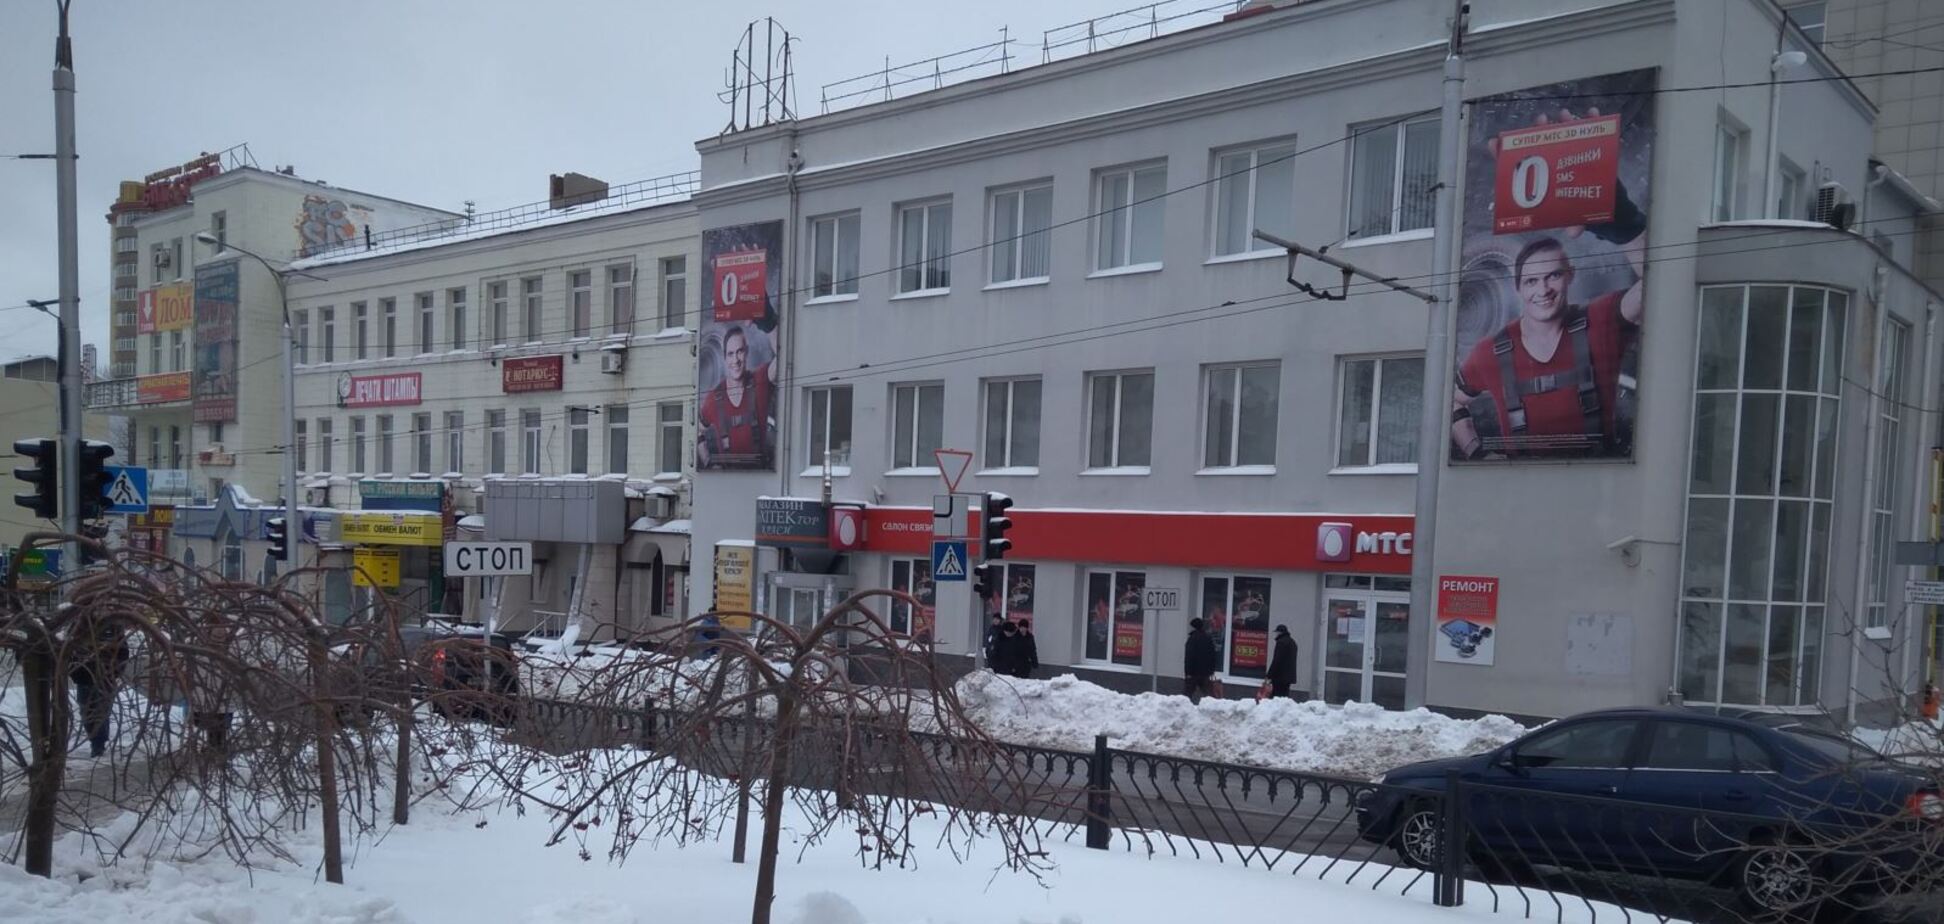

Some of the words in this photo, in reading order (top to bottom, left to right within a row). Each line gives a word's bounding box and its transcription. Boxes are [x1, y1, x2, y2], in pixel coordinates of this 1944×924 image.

[1512, 134, 1541, 147] СУПЕР
[1544, 131, 1562, 142] МТС
[1579, 125, 1607, 136] НУЛЬ
[1556, 147, 1602, 170] ДЗВІНКИ
[1511, 155, 1549, 210] 0
[1556, 170, 1575, 184] SMS
[1554, 185, 1602, 199] ІНТЕРНЕТ
[721, 272, 738, 306] 0
[374, 525, 398, 533] ОБМЕН
[399, 526, 422, 535] ВАЛЮТ
[882, 522, 909, 531] САЛОН
[1356, 531, 1412, 554] МТС
[456, 547, 523, 571] СТОП
[1443, 580, 1495, 592] РЕМОНТ
[1147, 591, 1177, 607] СТОП
